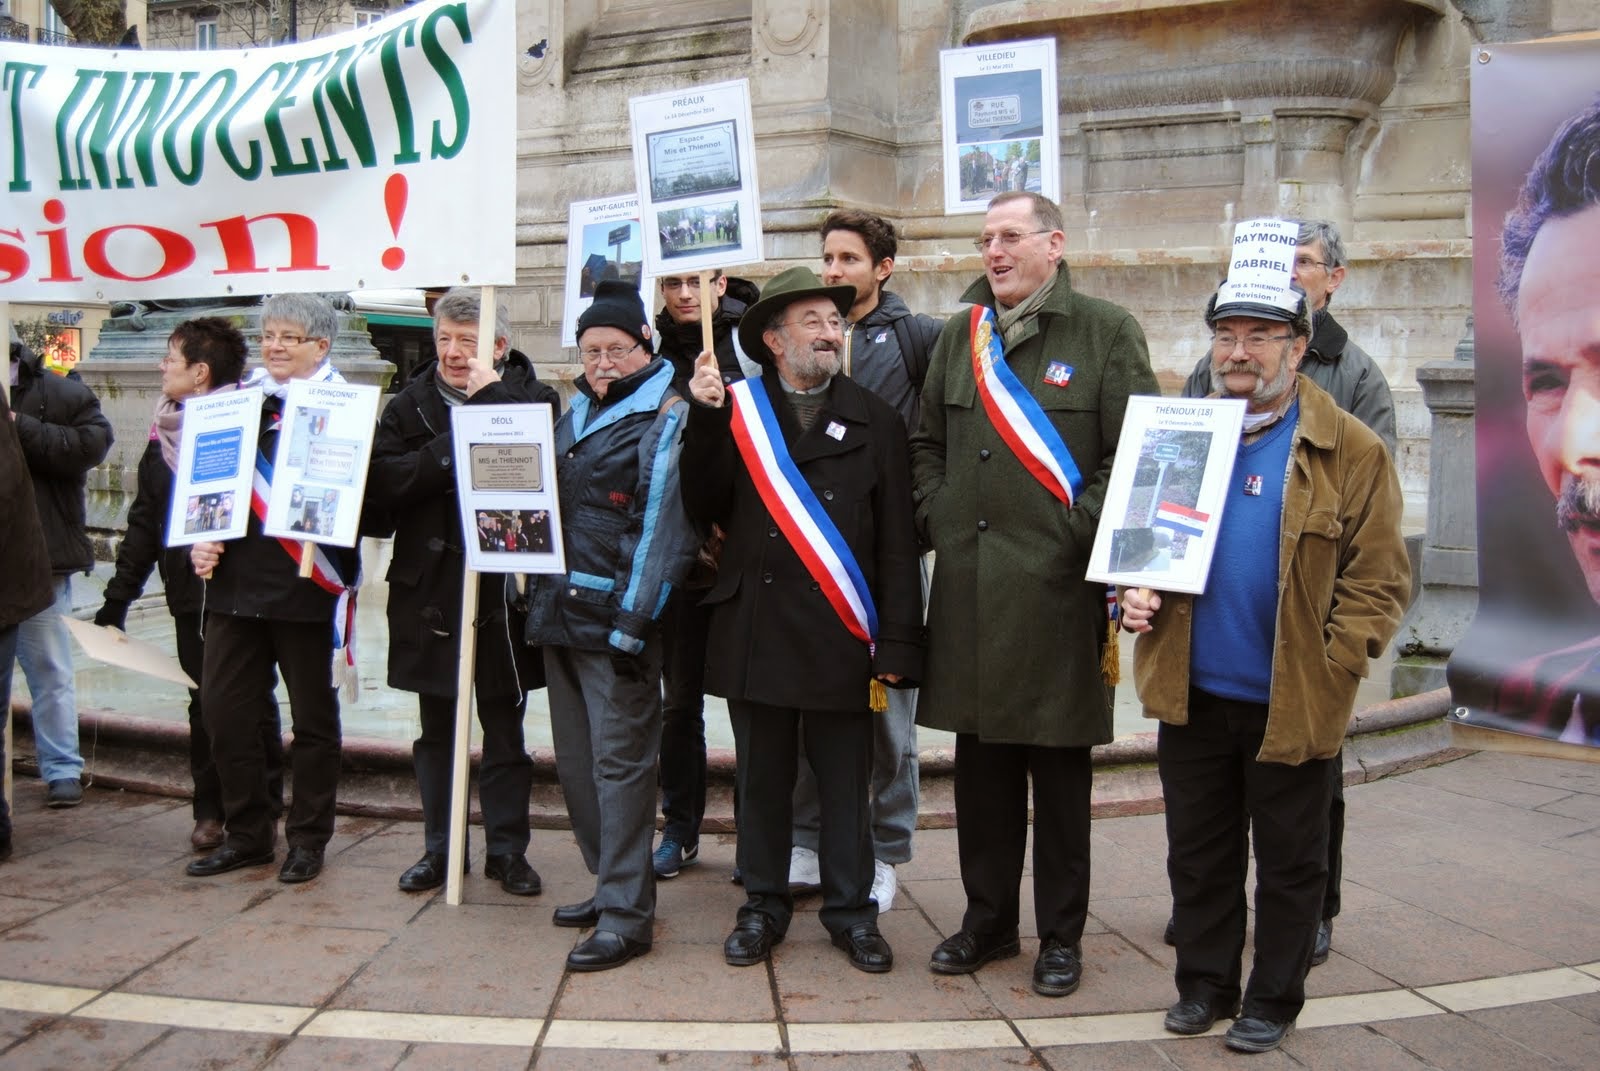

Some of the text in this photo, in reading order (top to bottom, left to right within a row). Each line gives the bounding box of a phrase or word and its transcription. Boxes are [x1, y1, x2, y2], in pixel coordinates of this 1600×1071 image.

[976, 51, 1016, 62] VILLEDIEU
[56, 2, 473, 190] INNOCENTS
[672, 95, 705, 108] PRÉAUX
[974, 110, 997, 118] Raymond
[992, 114, 1017, 122] THIENNOT
[679, 135, 705, 144] Espace
[664, 141, 721, 156] Mis et Thiennot
[588, 200, 639, 213] SAINT-GAULTIER
[381, 173, 408, 271] !
[1234, 232, 1298, 247] RAYMOND
[1234, 258, 1288, 273] GABRIEL
[1250, 282, 1285, 294] THIENNOT
[317, 388, 358, 399] POINÇONNET
[1155, 404, 1213, 417] THÉNIOUX (18)
[491, 415, 513, 425] DÉOLS
[498, 448, 512, 456] RUE
[499, 456, 533, 464] THIENNOT
